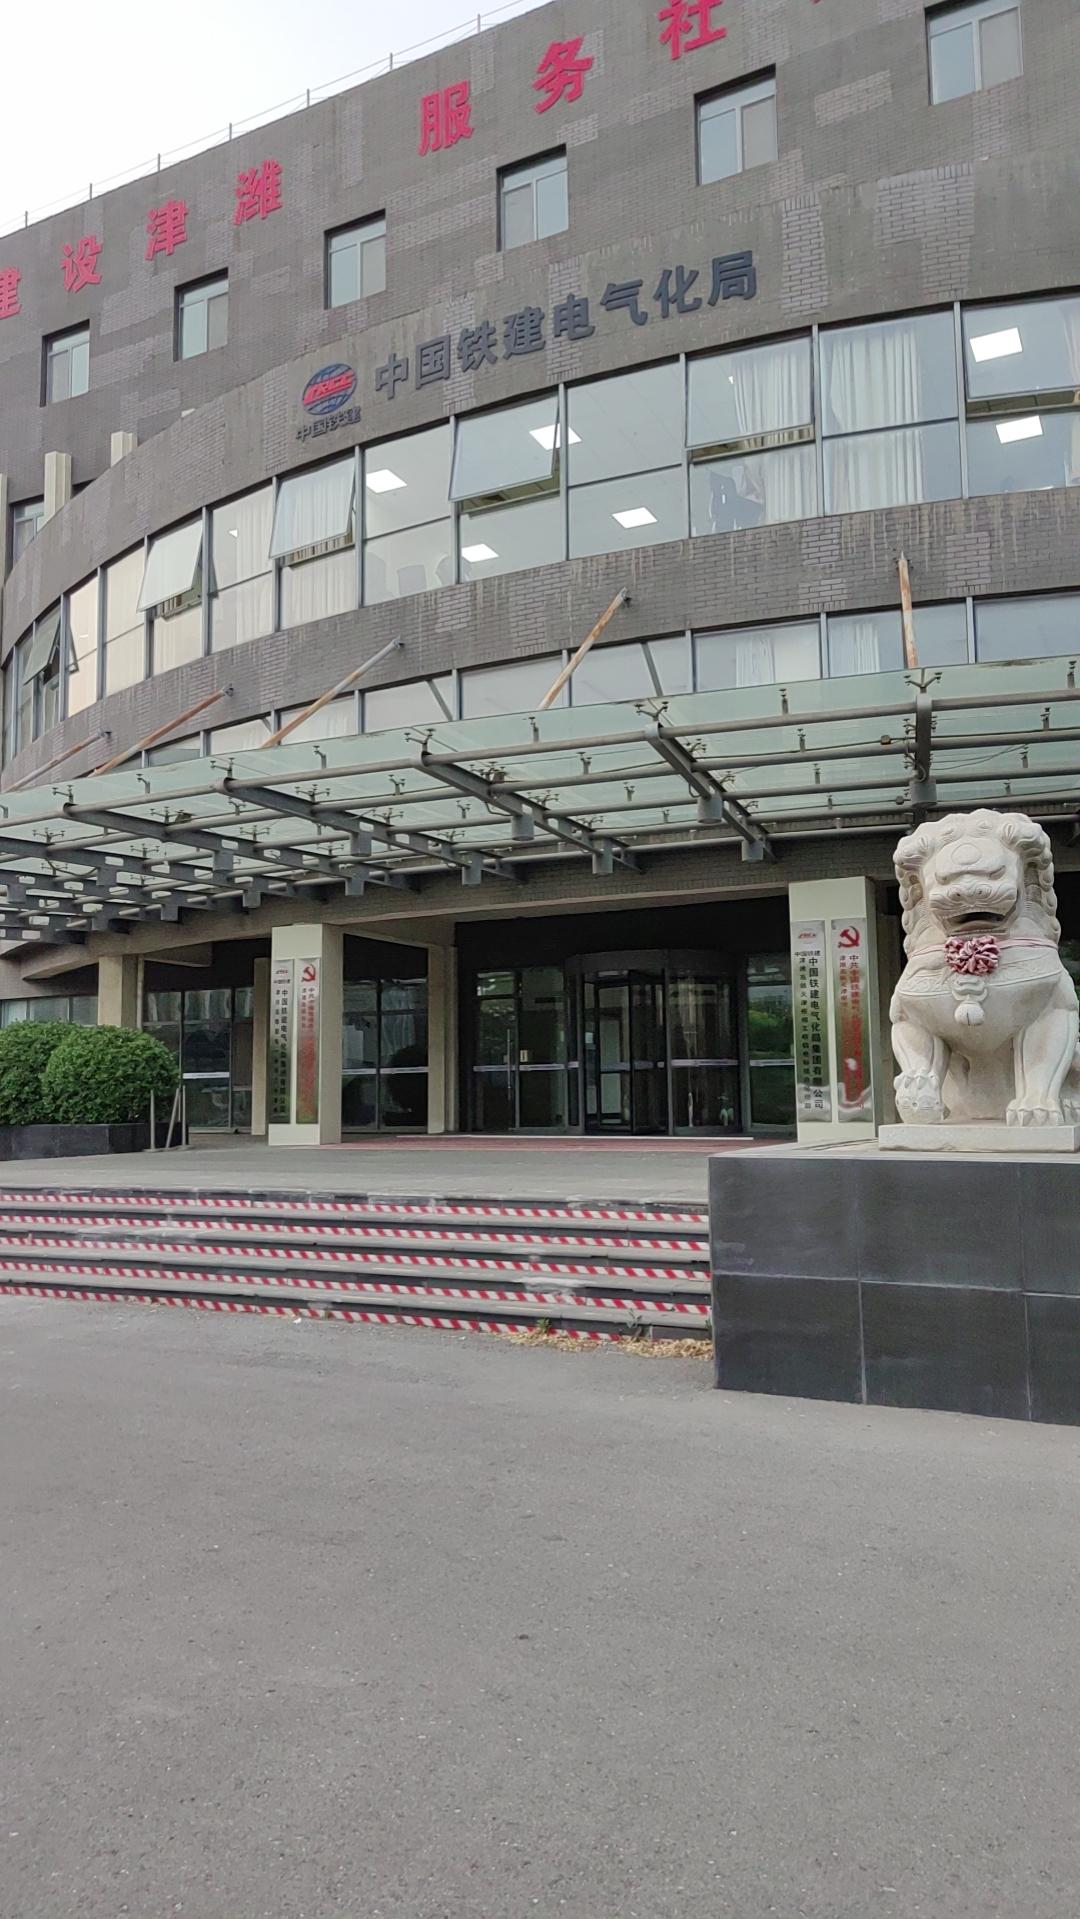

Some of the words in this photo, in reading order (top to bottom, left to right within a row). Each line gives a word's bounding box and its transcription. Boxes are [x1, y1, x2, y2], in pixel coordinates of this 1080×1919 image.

[375, 250, 757, 400] 中国铁建电气化局
[296, 406, 361, 442] 中国铁建
